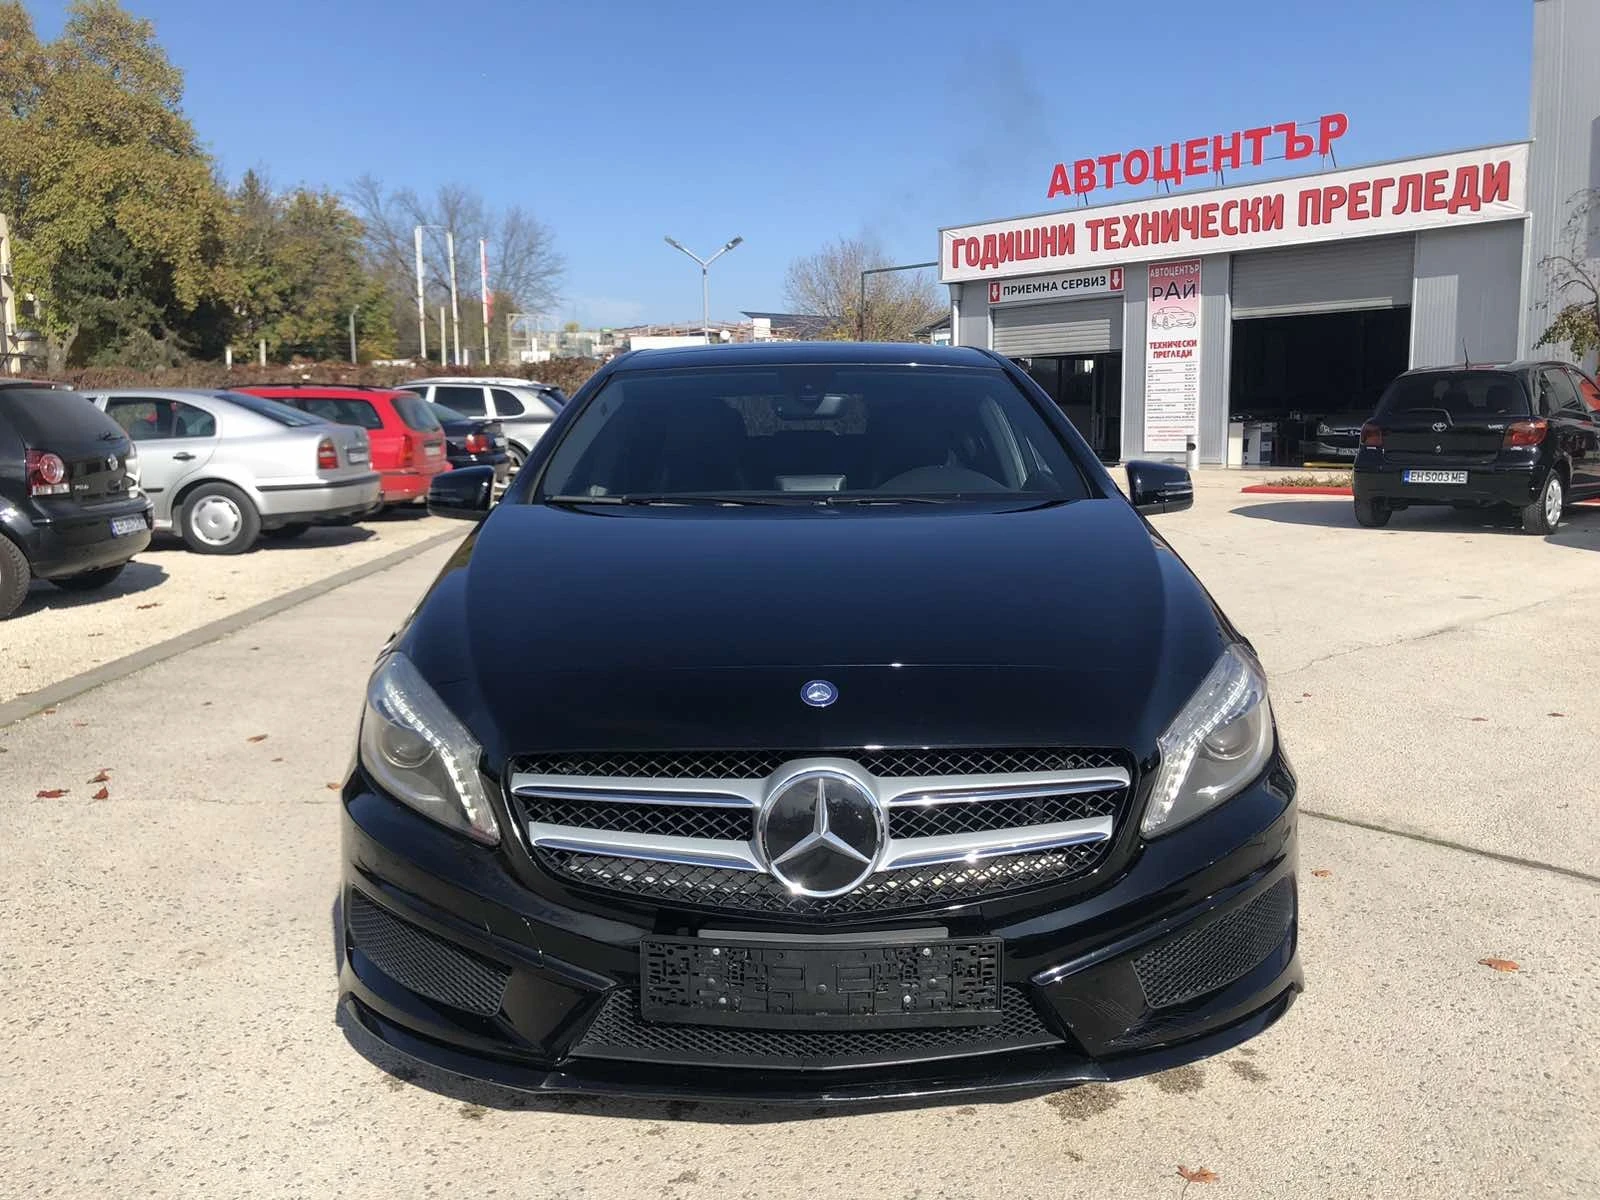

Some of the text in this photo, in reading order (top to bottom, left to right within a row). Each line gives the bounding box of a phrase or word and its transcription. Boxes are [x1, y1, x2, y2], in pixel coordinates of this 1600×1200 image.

[1047, 113, 1349, 199] АВТОЦЕНТЪР
[951, 160, 1511, 271] ГОДИШНИ ТЕХНИЧЕСКИ ПРЕГЛЕДИ
[1150, 264, 1200, 277] АВТОЦЕНТЪР
[1002, 276, 1106, 296] ПРИЕМНА СЕРВИЗ
[1149, 339, 1197, 349] ТЕХНИЧЕСКИ
[1153, 349, 1193, 359] ПРЕГЛЕДИ
